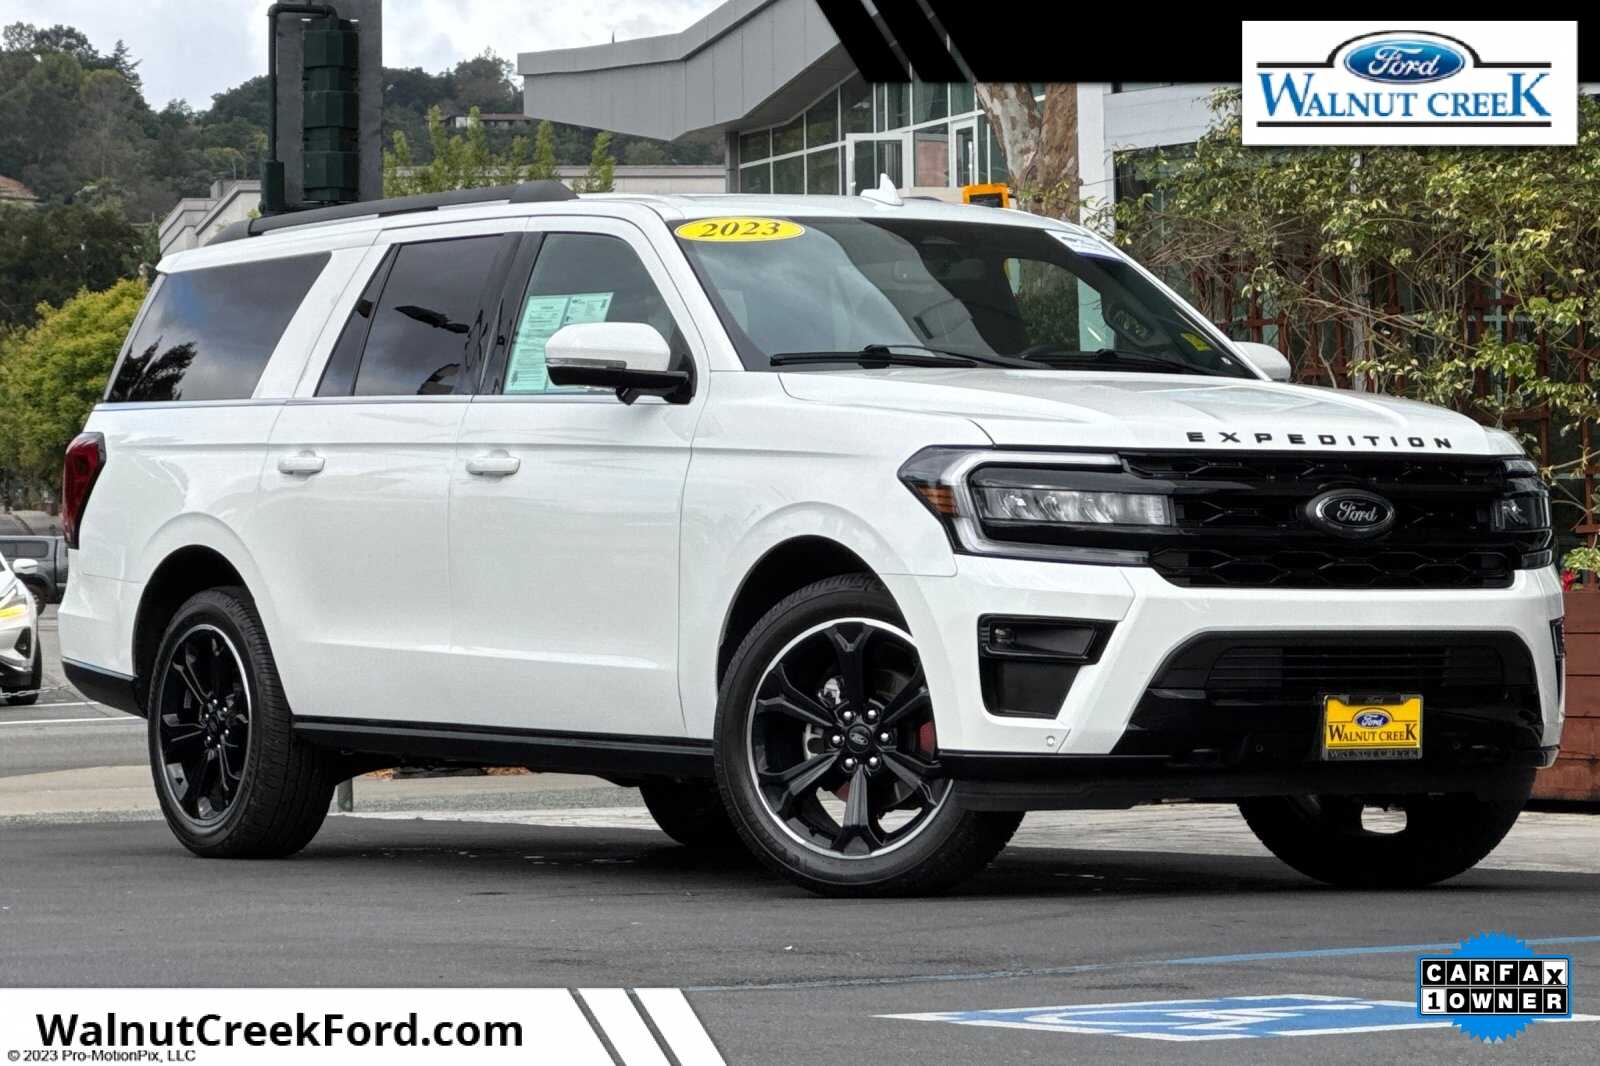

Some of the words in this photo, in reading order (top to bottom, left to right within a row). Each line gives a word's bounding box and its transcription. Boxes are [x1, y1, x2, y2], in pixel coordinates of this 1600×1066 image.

[699, 221, 782, 237] 2023
[1186, 431, 1452, 448] EXPEDITION
[1336, 500, 1379, 522] Ford
[1361, 714, 1384, 726] Ford
[1328, 724, 1377, 742] WALNUT
[1378, 723, 1417, 741] CREEK
